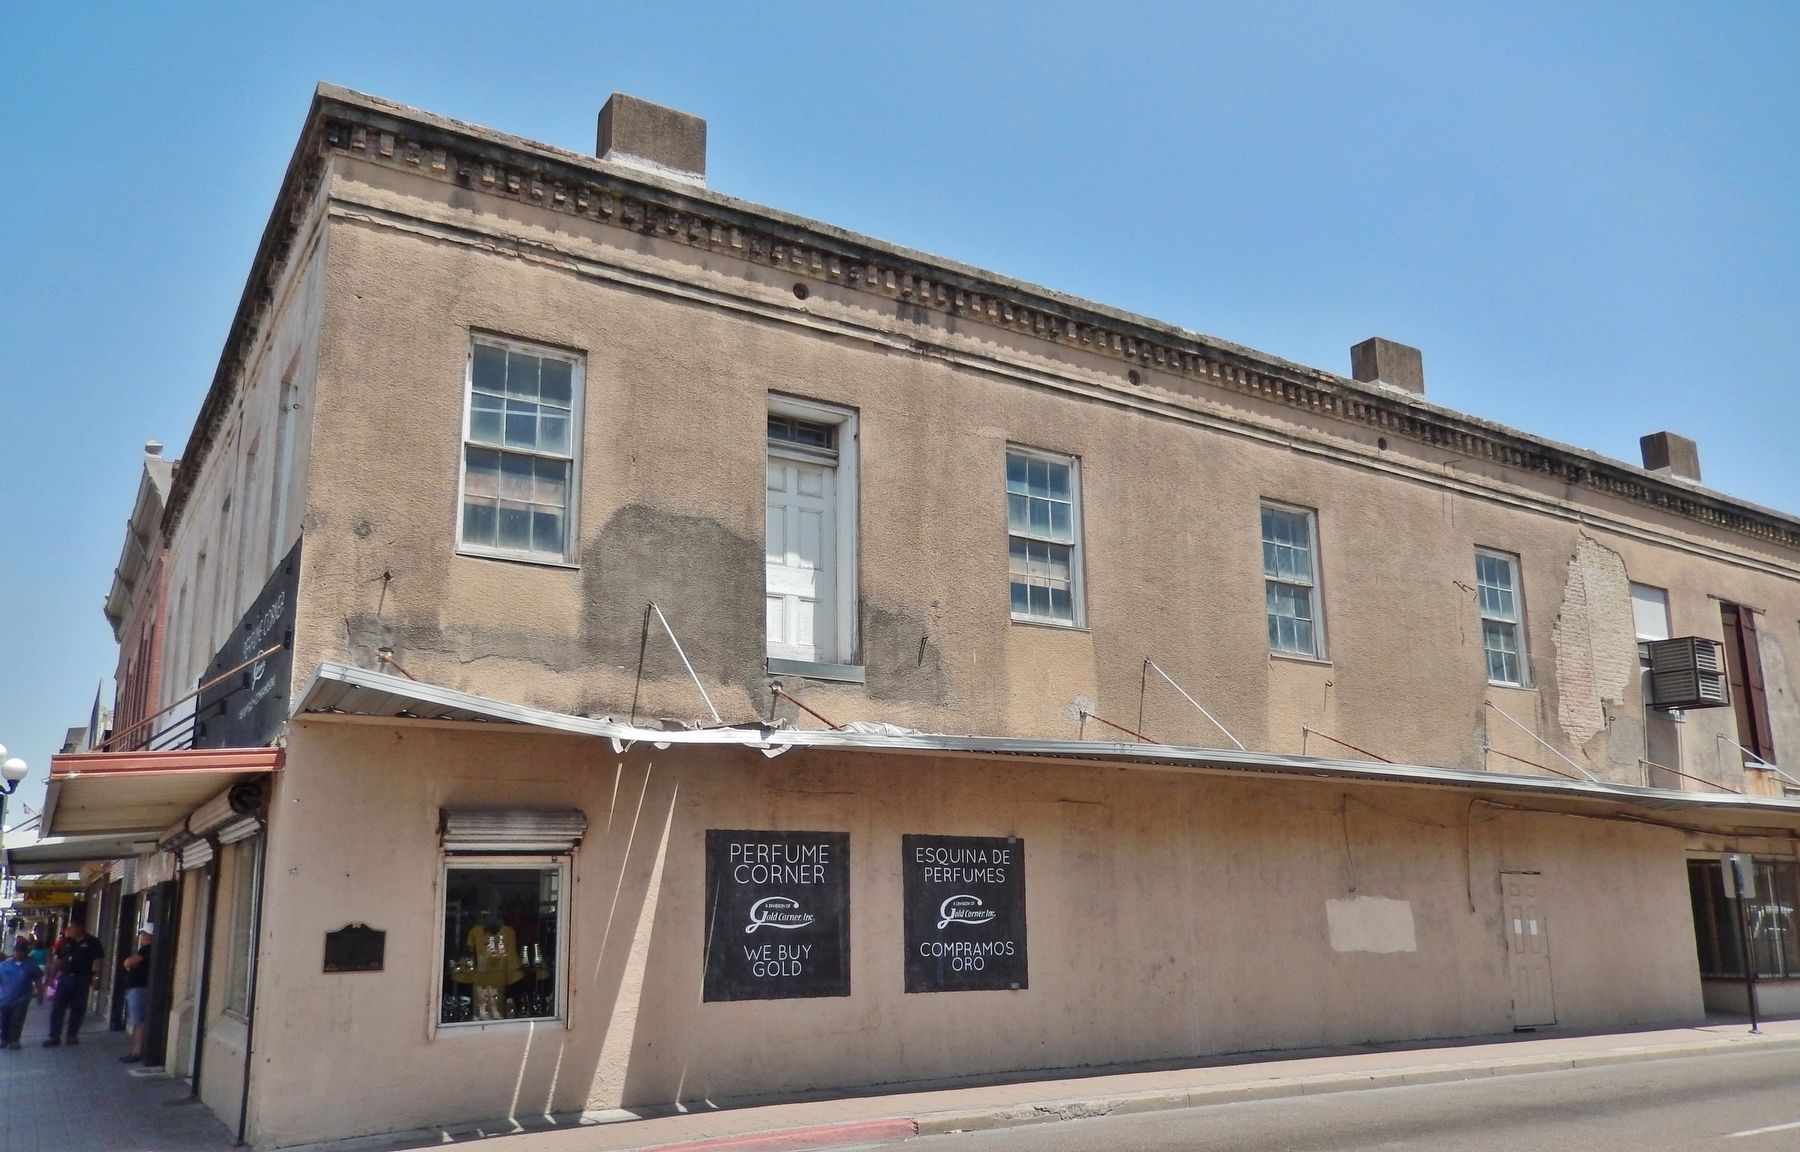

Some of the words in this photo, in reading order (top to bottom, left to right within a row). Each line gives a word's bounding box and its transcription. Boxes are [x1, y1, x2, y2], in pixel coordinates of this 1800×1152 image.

[730, 843, 829, 865] PERFUME
[916, 847, 988, 865] ESQUINA
[992, 849, 1011, 865] DE
[734, 864, 826, 884] CORNER
[924, 868, 1006, 883] PERFUMES
[802, 912, 816, 921] Inc.
[743, 945, 772, 961] WE
[778, 944, 812, 961] BUY
[920, 941, 1015, 957] COMPRAMOS
[752, 961, 802, 977] GOLD
[951, 956, 985, 971] ORO
